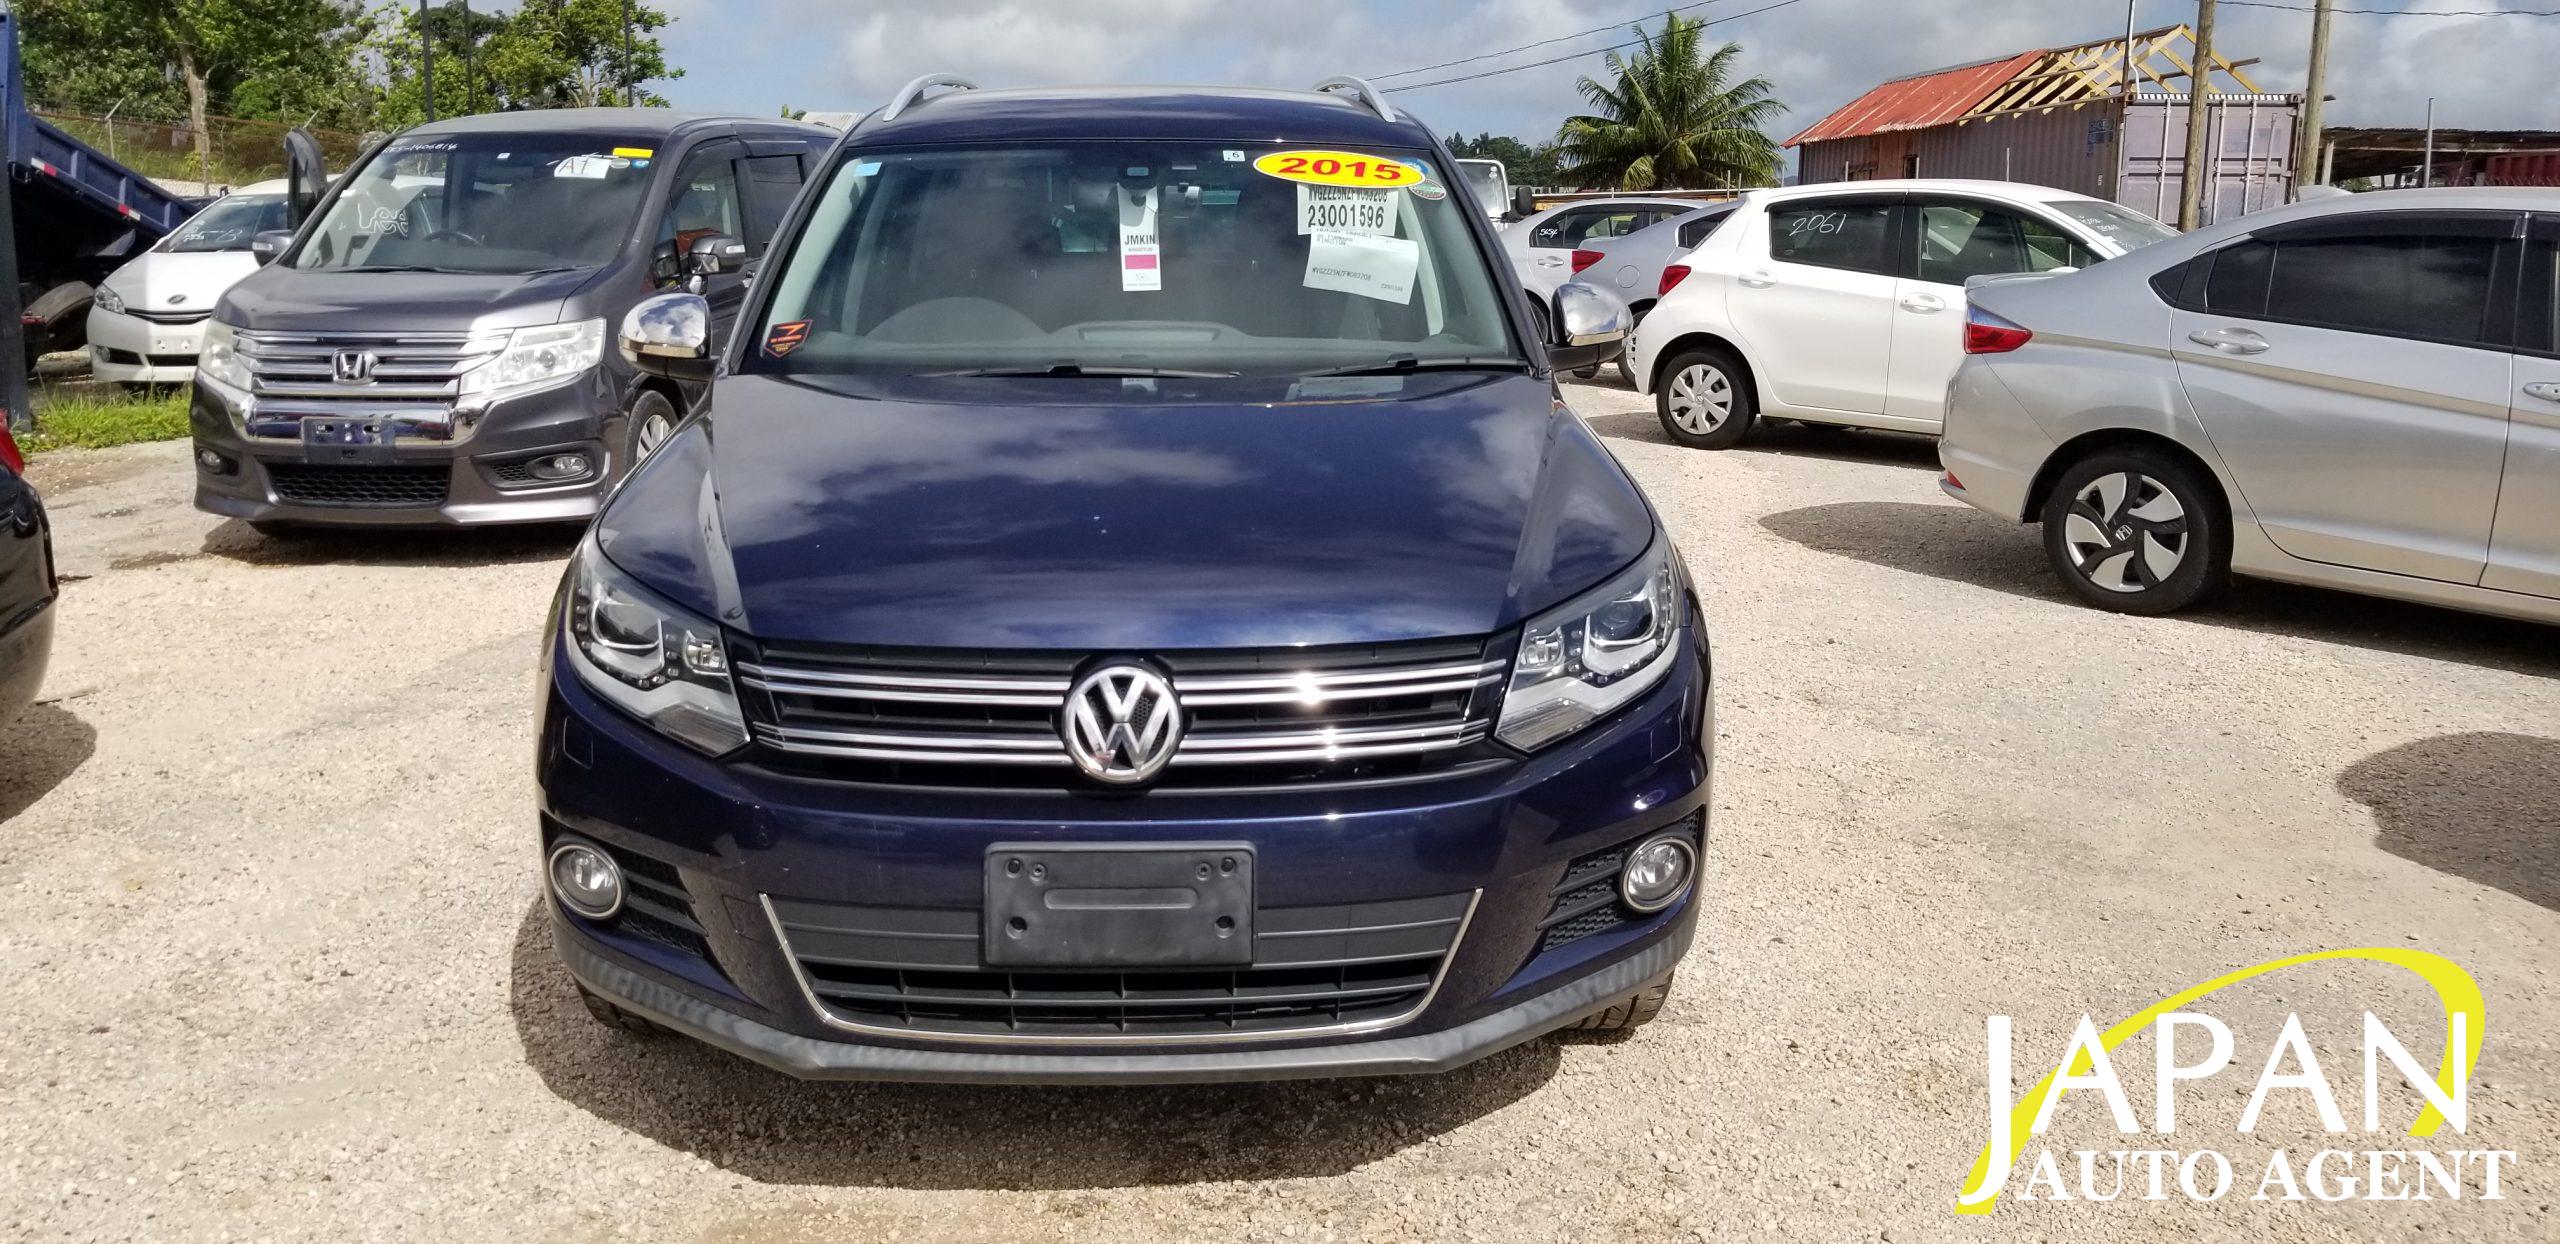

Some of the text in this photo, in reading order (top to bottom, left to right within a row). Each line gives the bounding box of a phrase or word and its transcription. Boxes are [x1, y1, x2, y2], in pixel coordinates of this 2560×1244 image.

[1278, 157, 1401, 181] 2015
[1308, 204, 1385, 229] 23001596
[1788, 212, 1847, 237] 2061
[1125, 234, 1156, 246] JMKIN
